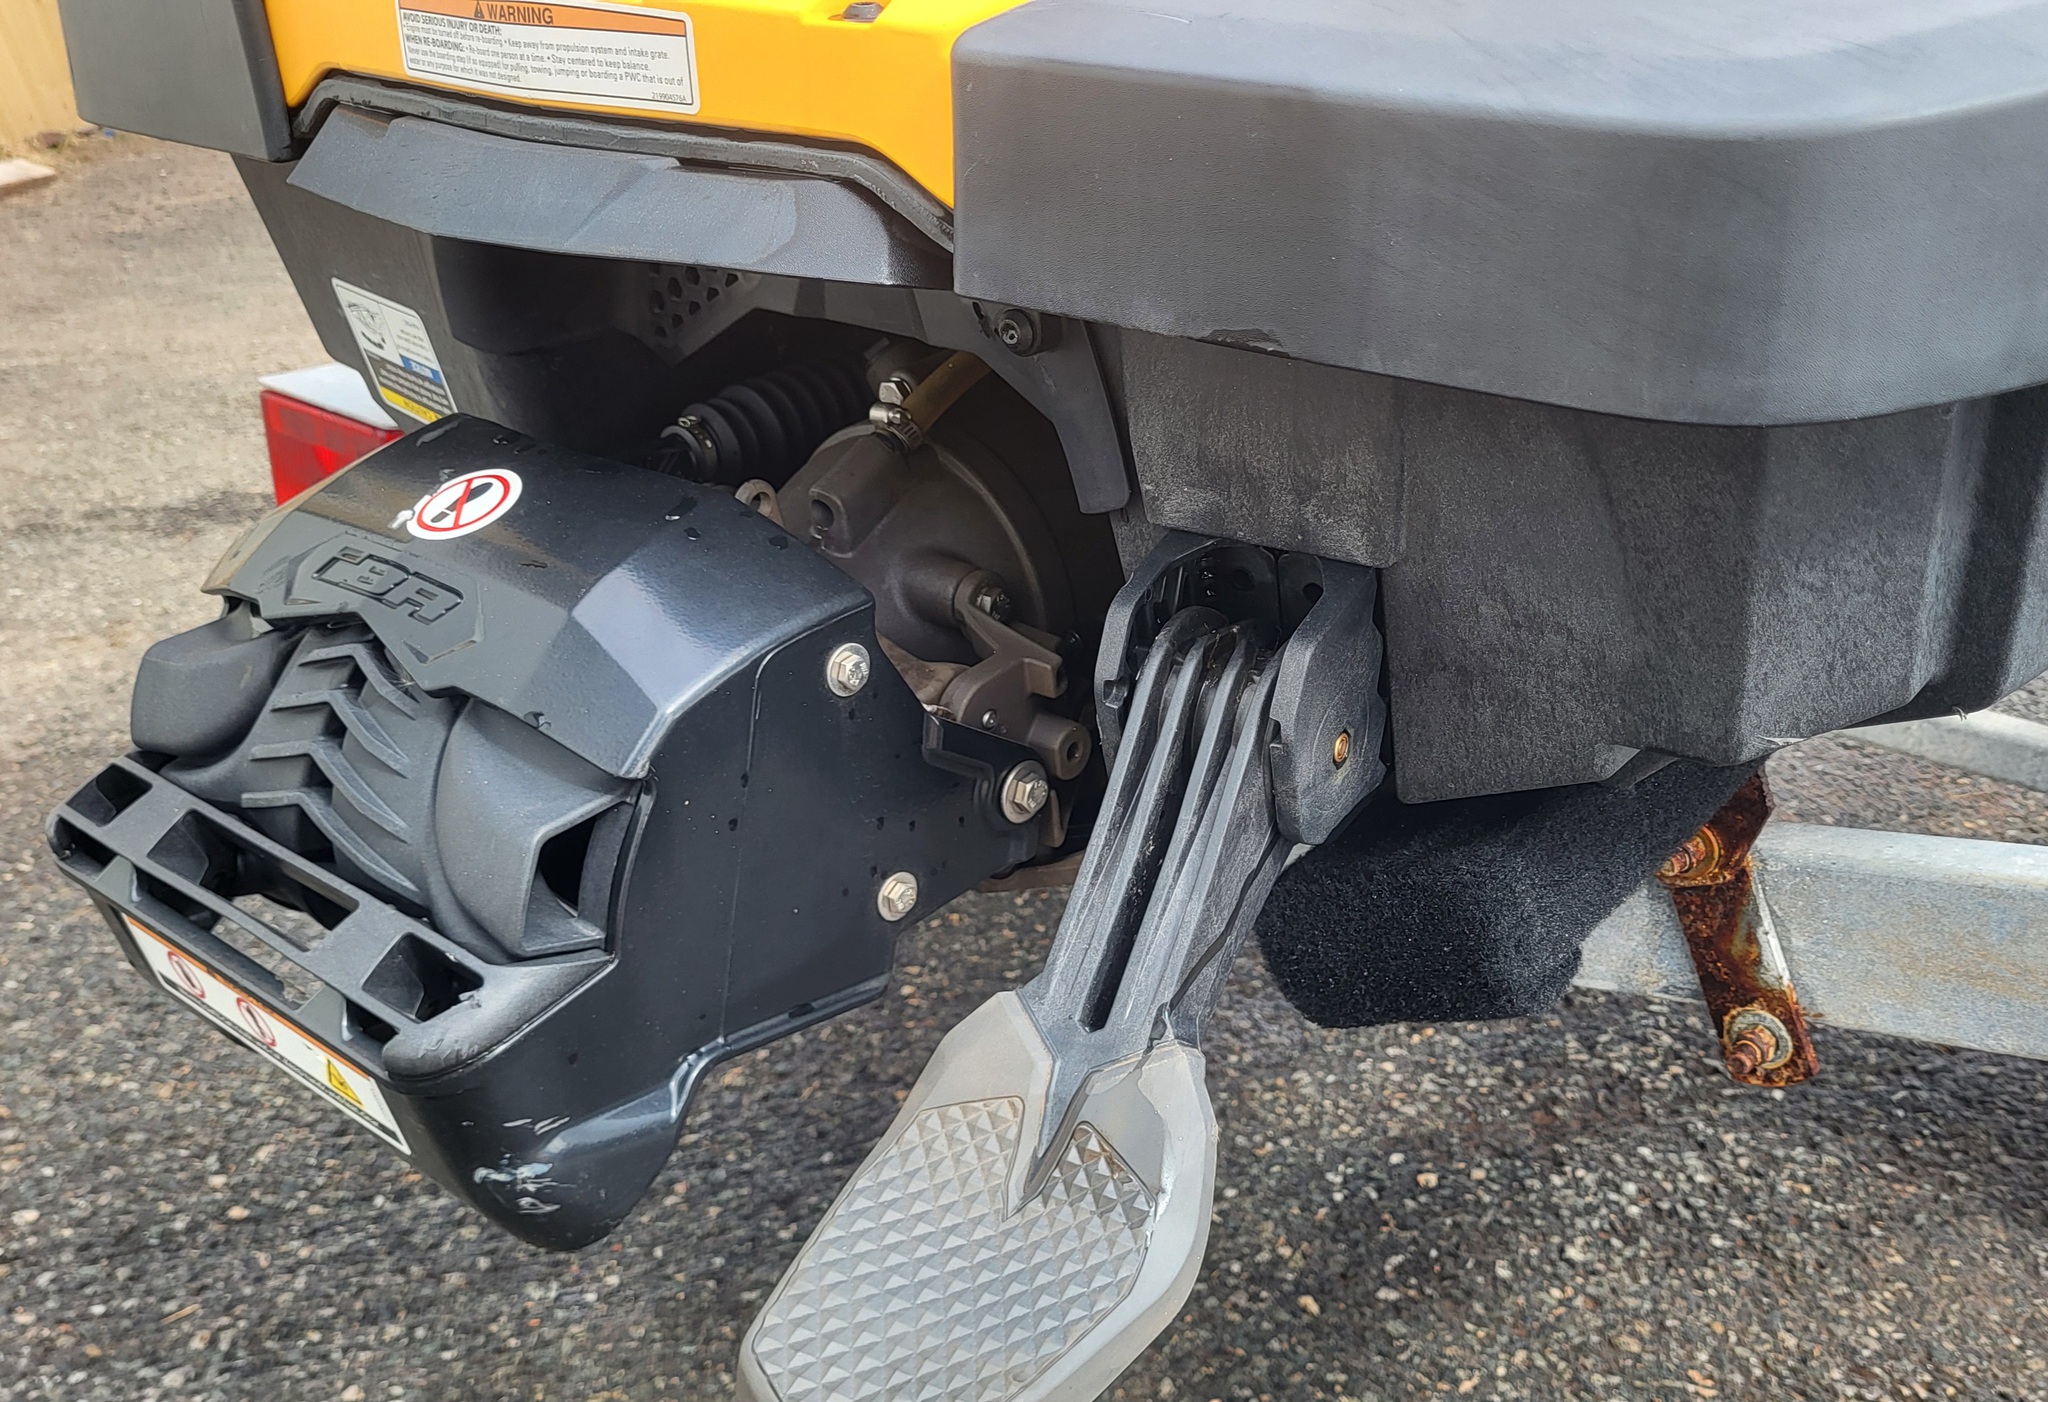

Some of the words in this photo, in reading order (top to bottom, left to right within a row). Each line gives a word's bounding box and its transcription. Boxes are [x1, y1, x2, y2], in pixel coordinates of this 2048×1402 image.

[403, 12, 421, 23] AVOID
[421, 14, 446, 28] SERIOUS
[446, 18, 468, 31] INJURY
[468, 22, 479, 32] OR
[479, 23, 502, 35] DEATH:
[487, 3, 554, 25] WARNING
[405, 33, 422, 45] WHEN
[422, 36, 465, 53] RE-BOARDING:
[491, 50, 500, 58] one
[501, 51, 518, 62] person
[531, 52, 546, 63] time.
[551, 53, 566, 66] Stay
[567, 56, 596, 67] centered
[596, 57, 604, 67] to
[605, 58, 621, 70] keep
[622, 60, 651, 72] balance.
[508, 39, 521, 50] Keep
[523, 40, 539, 51] away
[540, 40, 555, 50] from
[556, 42, 589, 53] propulsion
[590, 45, 613, 56] system
[615, 46, 627, 56] and
[628, 46, 649, 58] intake
[650, 49, 670, 60] grate.
[510, 62, 530, 75] pulling,
[531, 64, 553, 77] towing,
[554, 66, 580, 79] jumping
[581, 70, 588, 78] or
[589, 69, 618, 82] boarding
[625, 71, 641, 82] PWC
[642, 73, 657, 84] that
[657, 74, 664, 84] is
[664, 76, 676, 86] out
[677, 76, 684, 87] of
